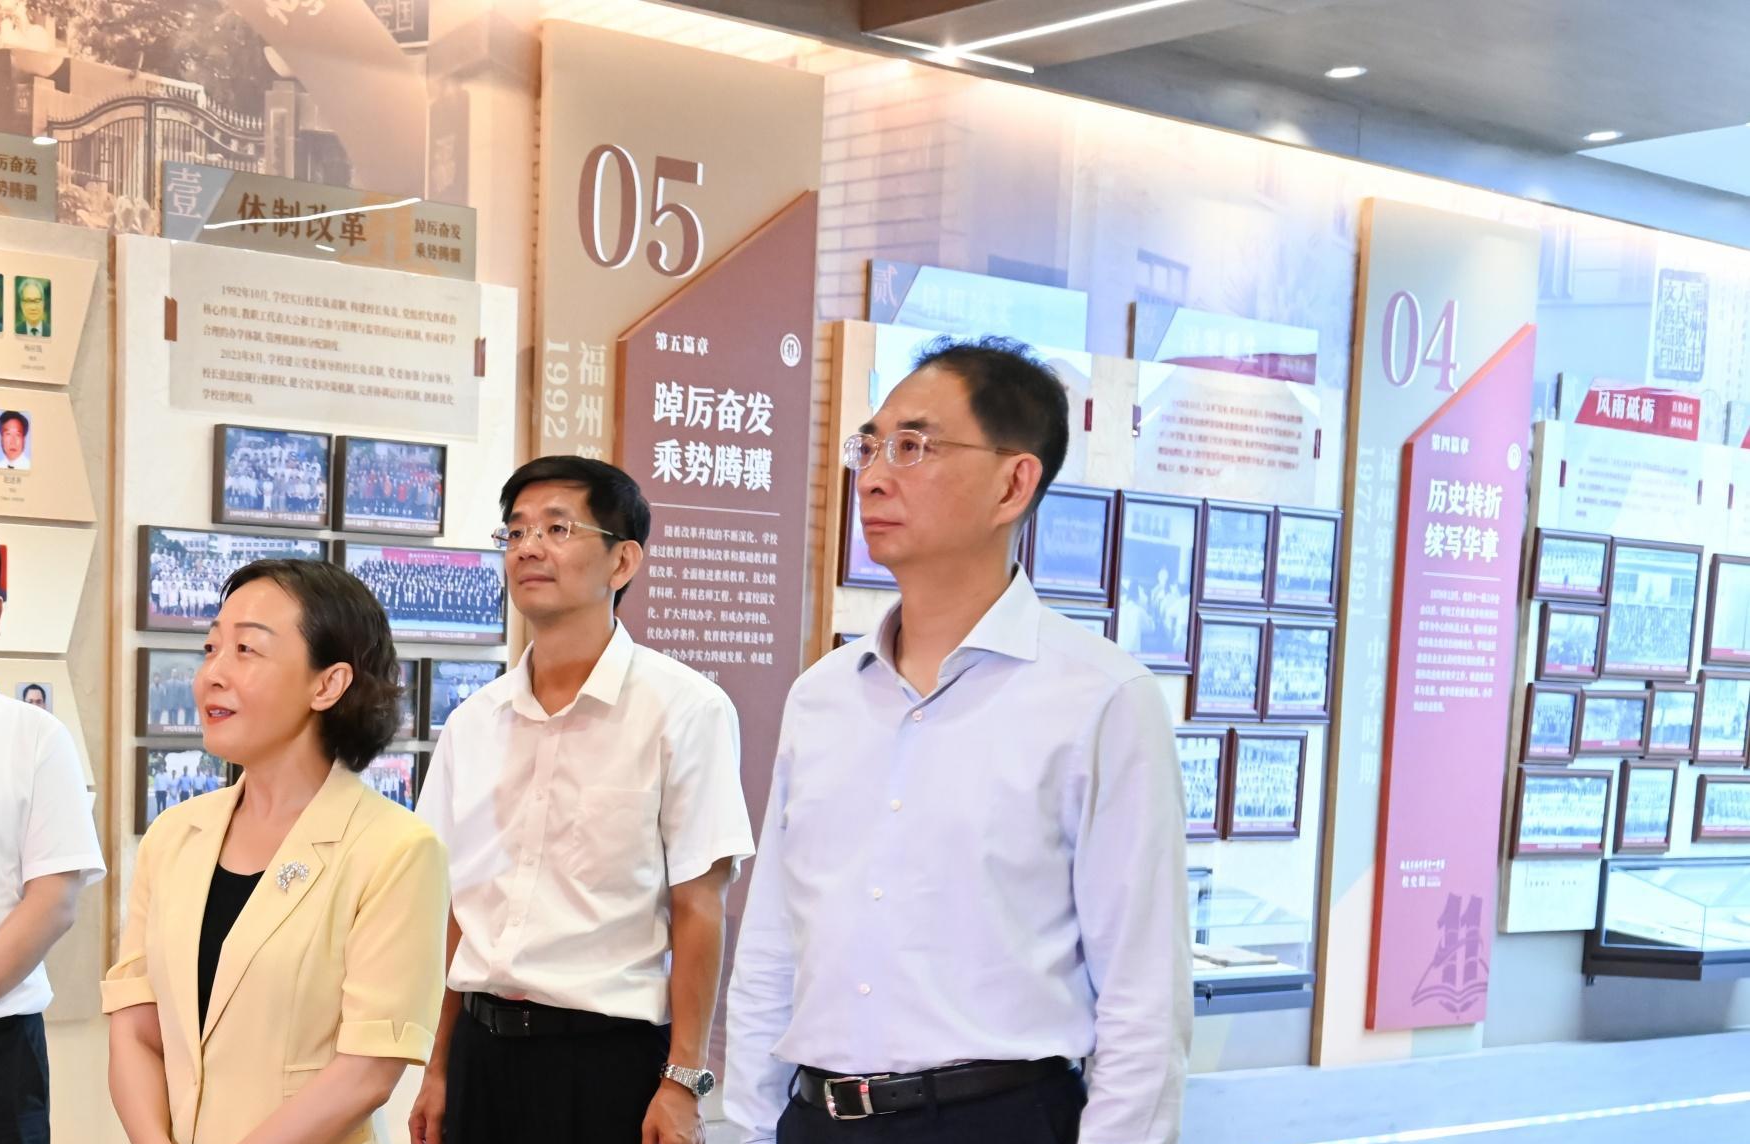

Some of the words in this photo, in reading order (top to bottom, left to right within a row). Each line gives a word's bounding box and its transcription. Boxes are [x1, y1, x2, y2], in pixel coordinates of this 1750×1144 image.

[166, 168, 203, 219] 壹
[578, 144, 704, 279] 05
[654, 331, 709, 357] 第五篇章
[1382, 290, 1460, 392] 04
[545, 338, 570, 439] 1992
[653, 381, 773, 436] 踔厉奋发
[652, 439, 772, 492] 乘势腾骥
[1427, 479, 1502, 520] 历史转折
[1424, 525, 1499, 562] 续写华章
